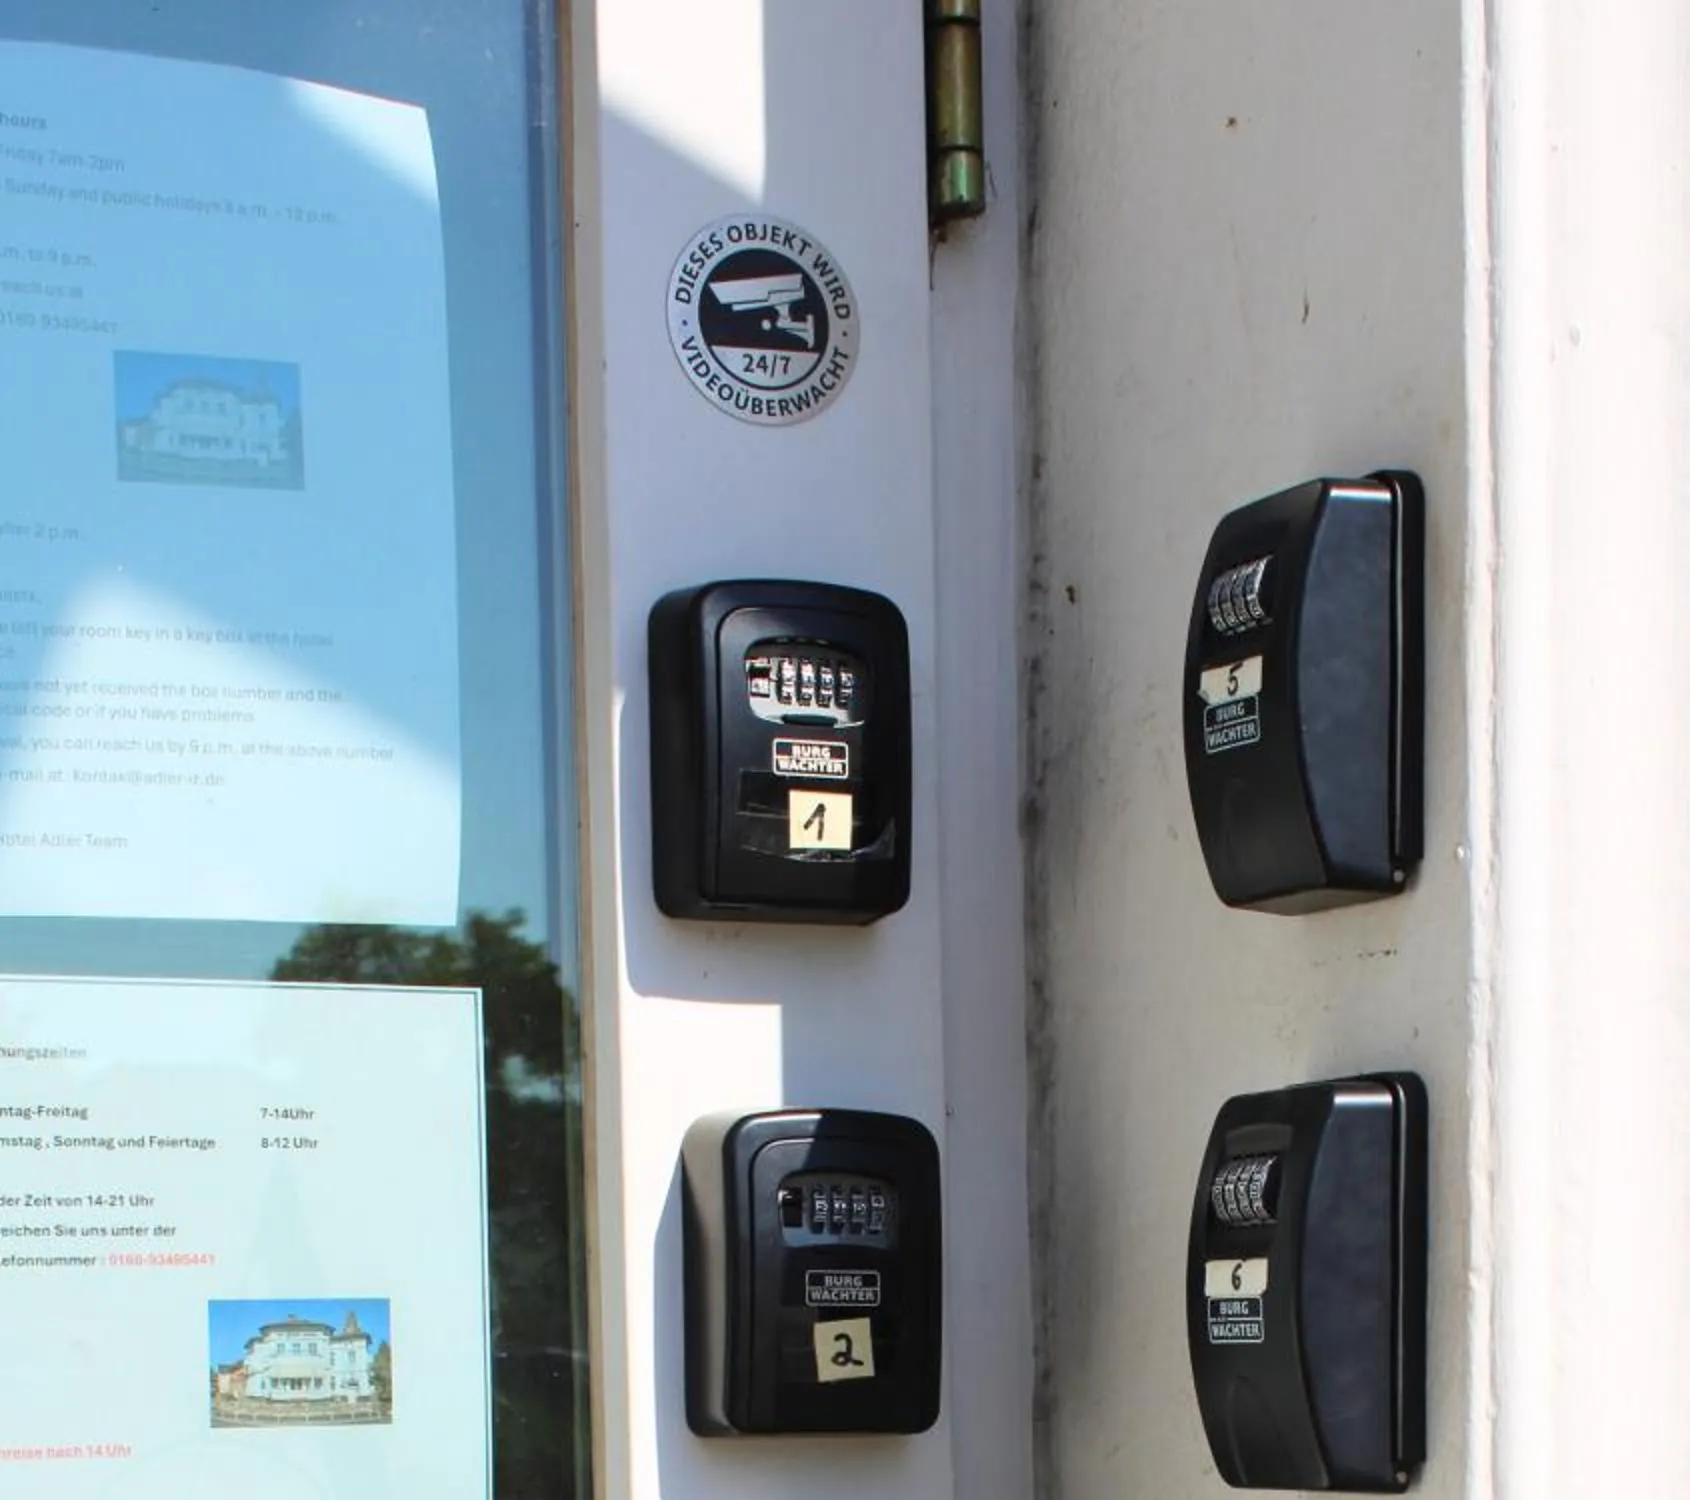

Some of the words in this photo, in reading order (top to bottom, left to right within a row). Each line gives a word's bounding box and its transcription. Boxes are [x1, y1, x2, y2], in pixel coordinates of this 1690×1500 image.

[675, 233, 723, 304] DIESES
[727, 223, 812, 257] OBJEKT
[812, 253, 850, 320] WIRD
[743, 353, 791, 378] 24/7
[681, 335, 849, 417] VIDEOÜBERWACHT
[1226, 660, 1244, 697] 5
[1215, 701, 1246, 723] BURG
[792, 744, 831, 760] BURG
[803, 803, 827, 842] 1
[117, 1135, 146, 1150] und
[148, 1134, 217, 1151] Feiertage
[292, 1135, 320, 1150] Uhr
[24, 1192, 53, 1208] Zeit
[56, 1195, 84, 1208] von
[128, 1193, 156, 1208] Uhr
[53, 1222, 78, 1238] Sie
[81, 1225, 109, 1238] uns
[111, 1224, 150, 1238] unter
[152, 1223, 177, 1238] der
[0, 1252, 97, 1268] efonnummer
[825, 1274, 863, 1287] BURG
[1231, 1262, 1243, 1291] 6
[1219, 1300, 1250, 1315] BURG
[831, 1332, 865, 1367] 2
